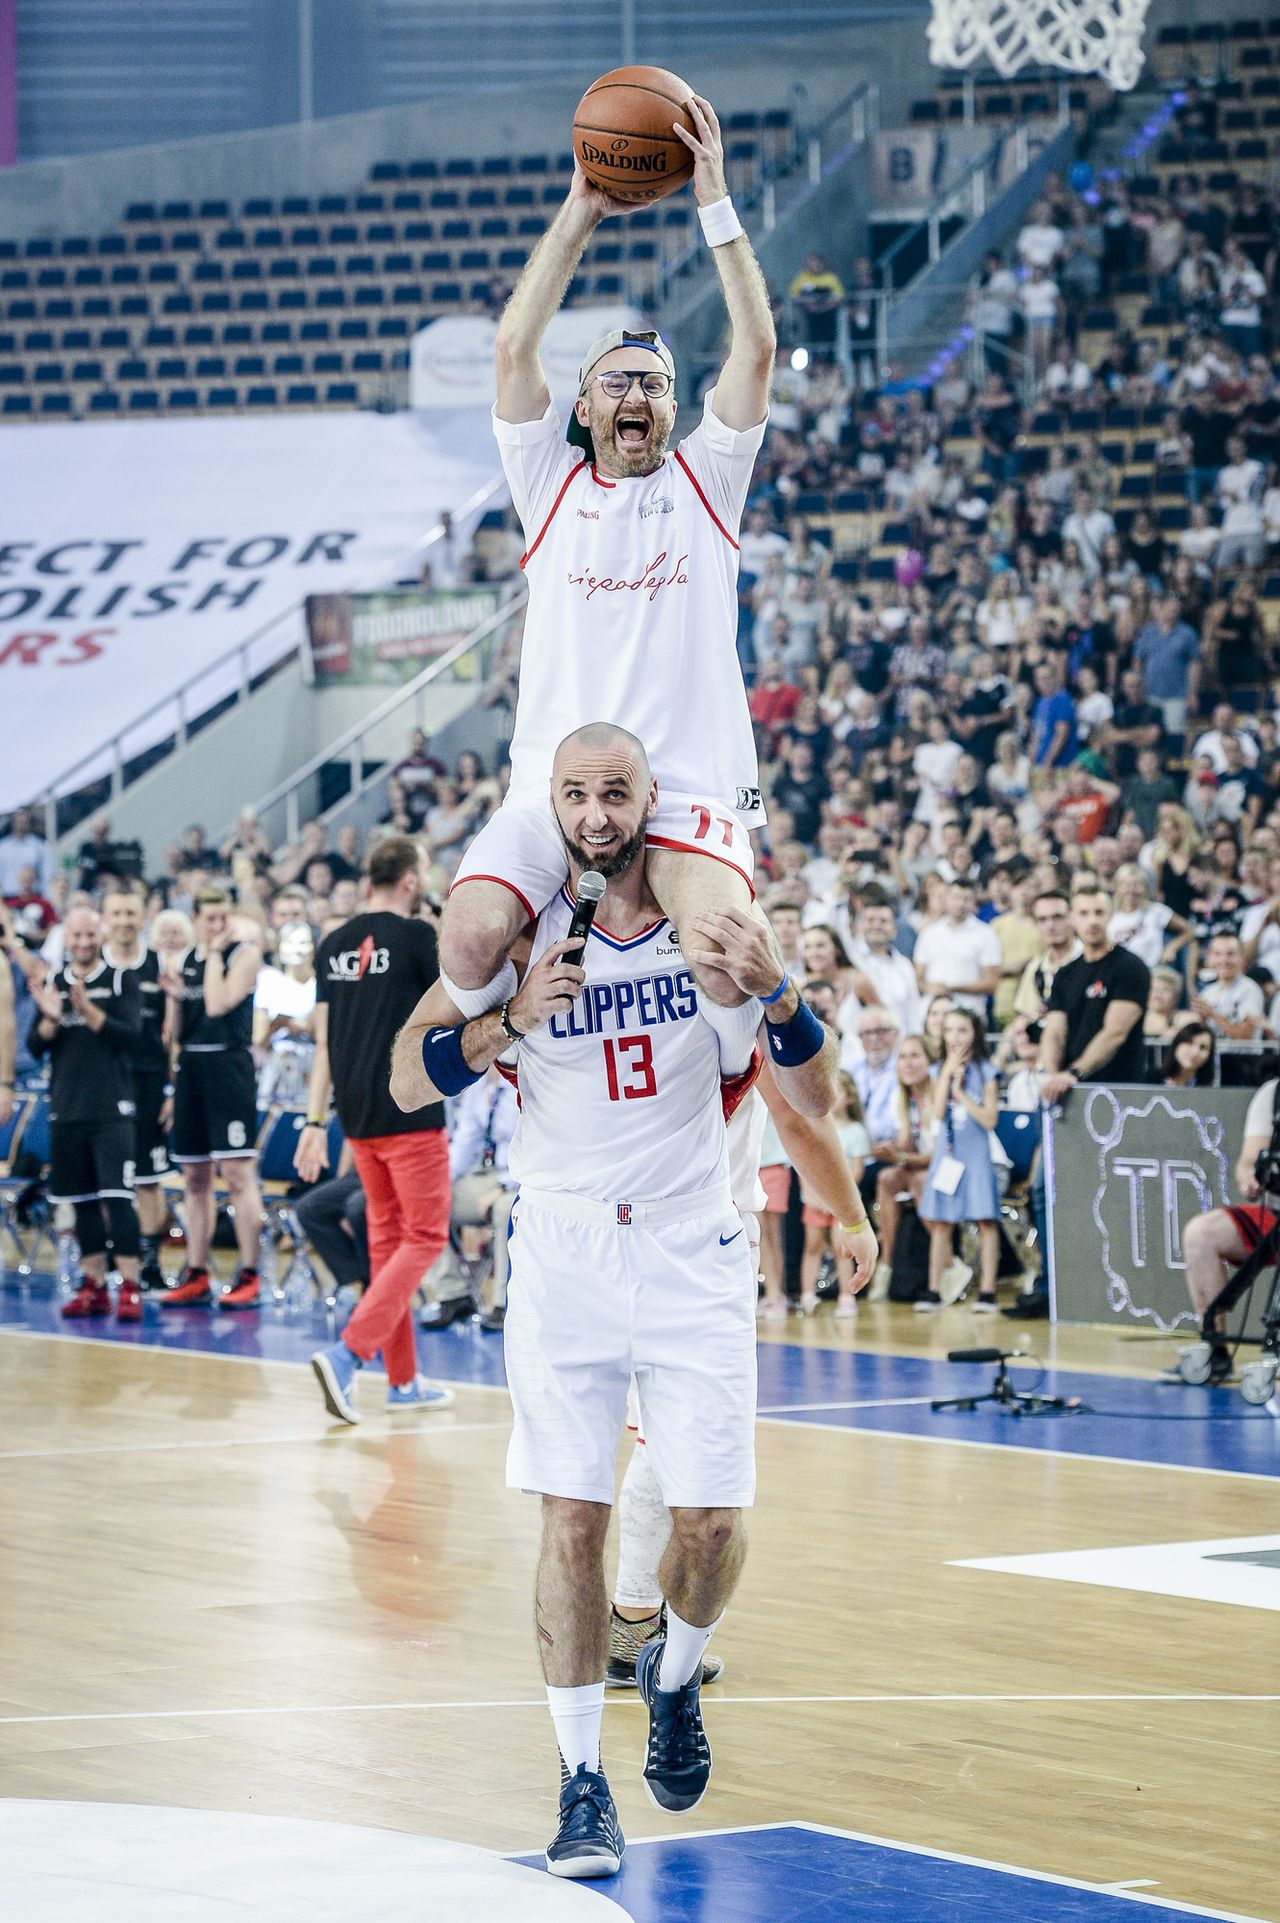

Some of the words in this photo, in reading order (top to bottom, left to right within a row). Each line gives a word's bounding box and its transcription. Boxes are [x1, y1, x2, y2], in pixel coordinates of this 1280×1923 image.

[582, 141, 667, 172] SPALDING
[170, 531, 359, 572] FOR
[656, 946, 683, 956] bum
[603, 1034, 658, 1101] 13
[228, 1120, 247, 1148] 6
